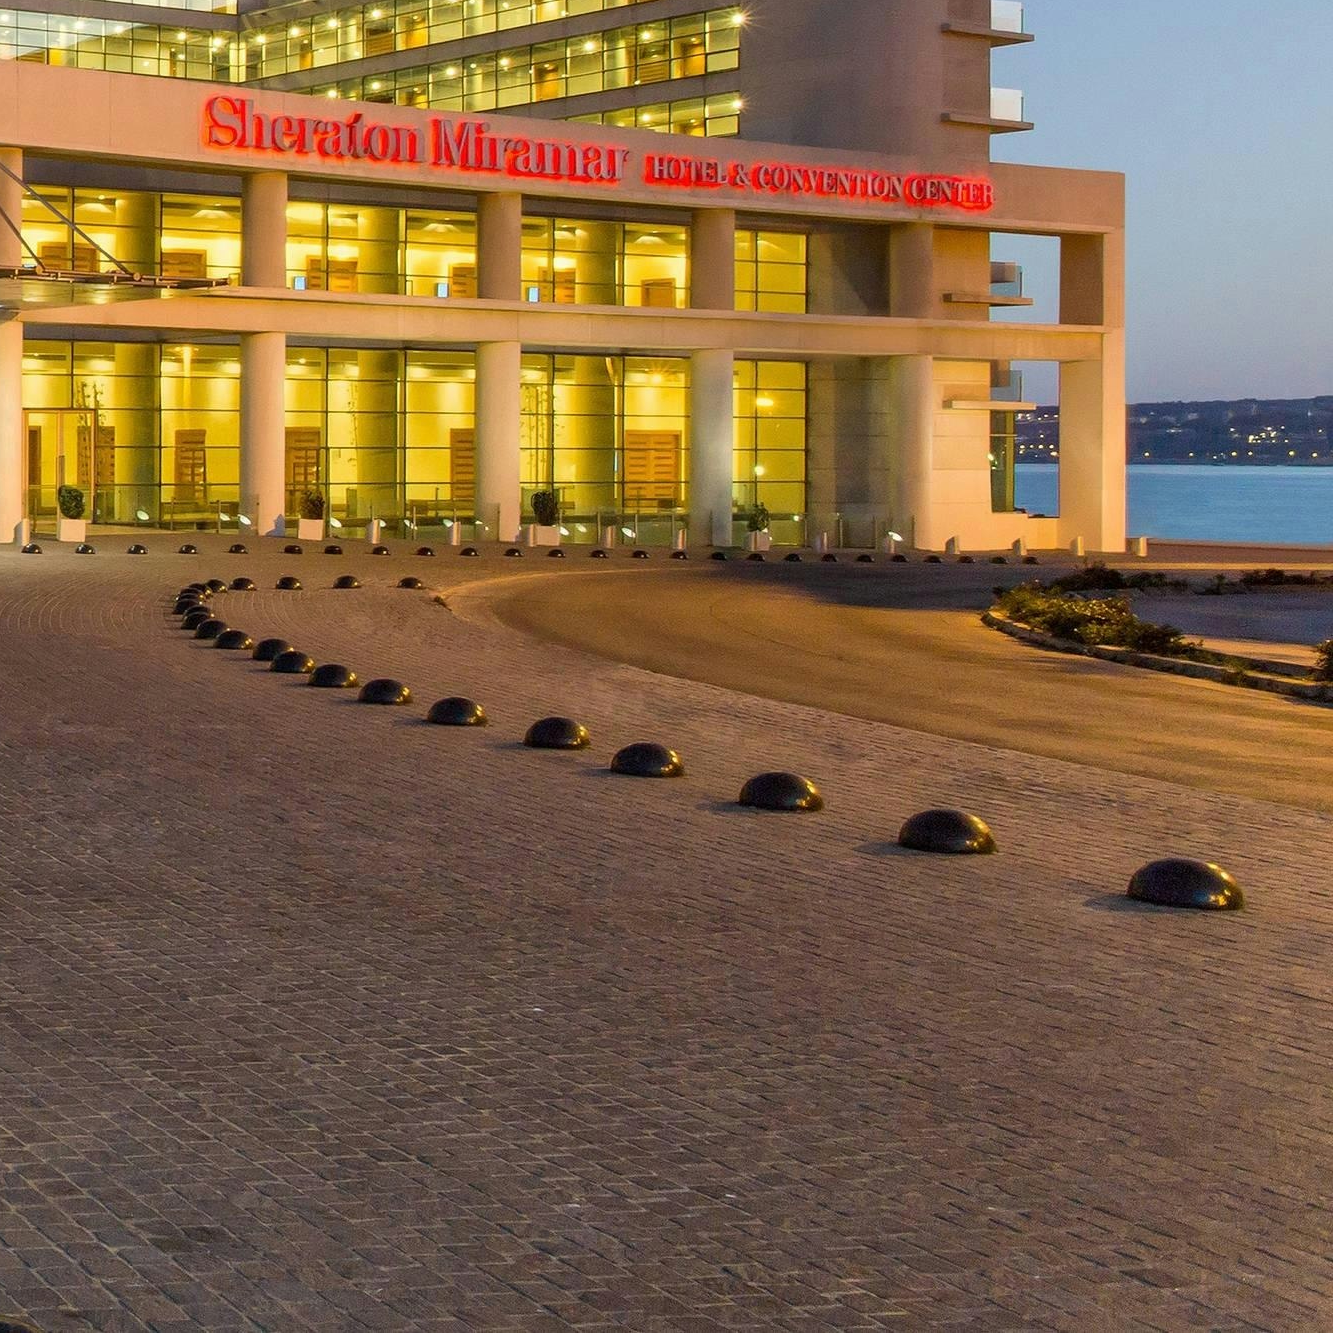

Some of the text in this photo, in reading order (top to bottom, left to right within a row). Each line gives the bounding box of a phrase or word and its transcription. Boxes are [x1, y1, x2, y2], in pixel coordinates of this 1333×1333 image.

[205, 94, 995, 208] Sheraton Miramar HOTEL & CONVENTION CENTER
